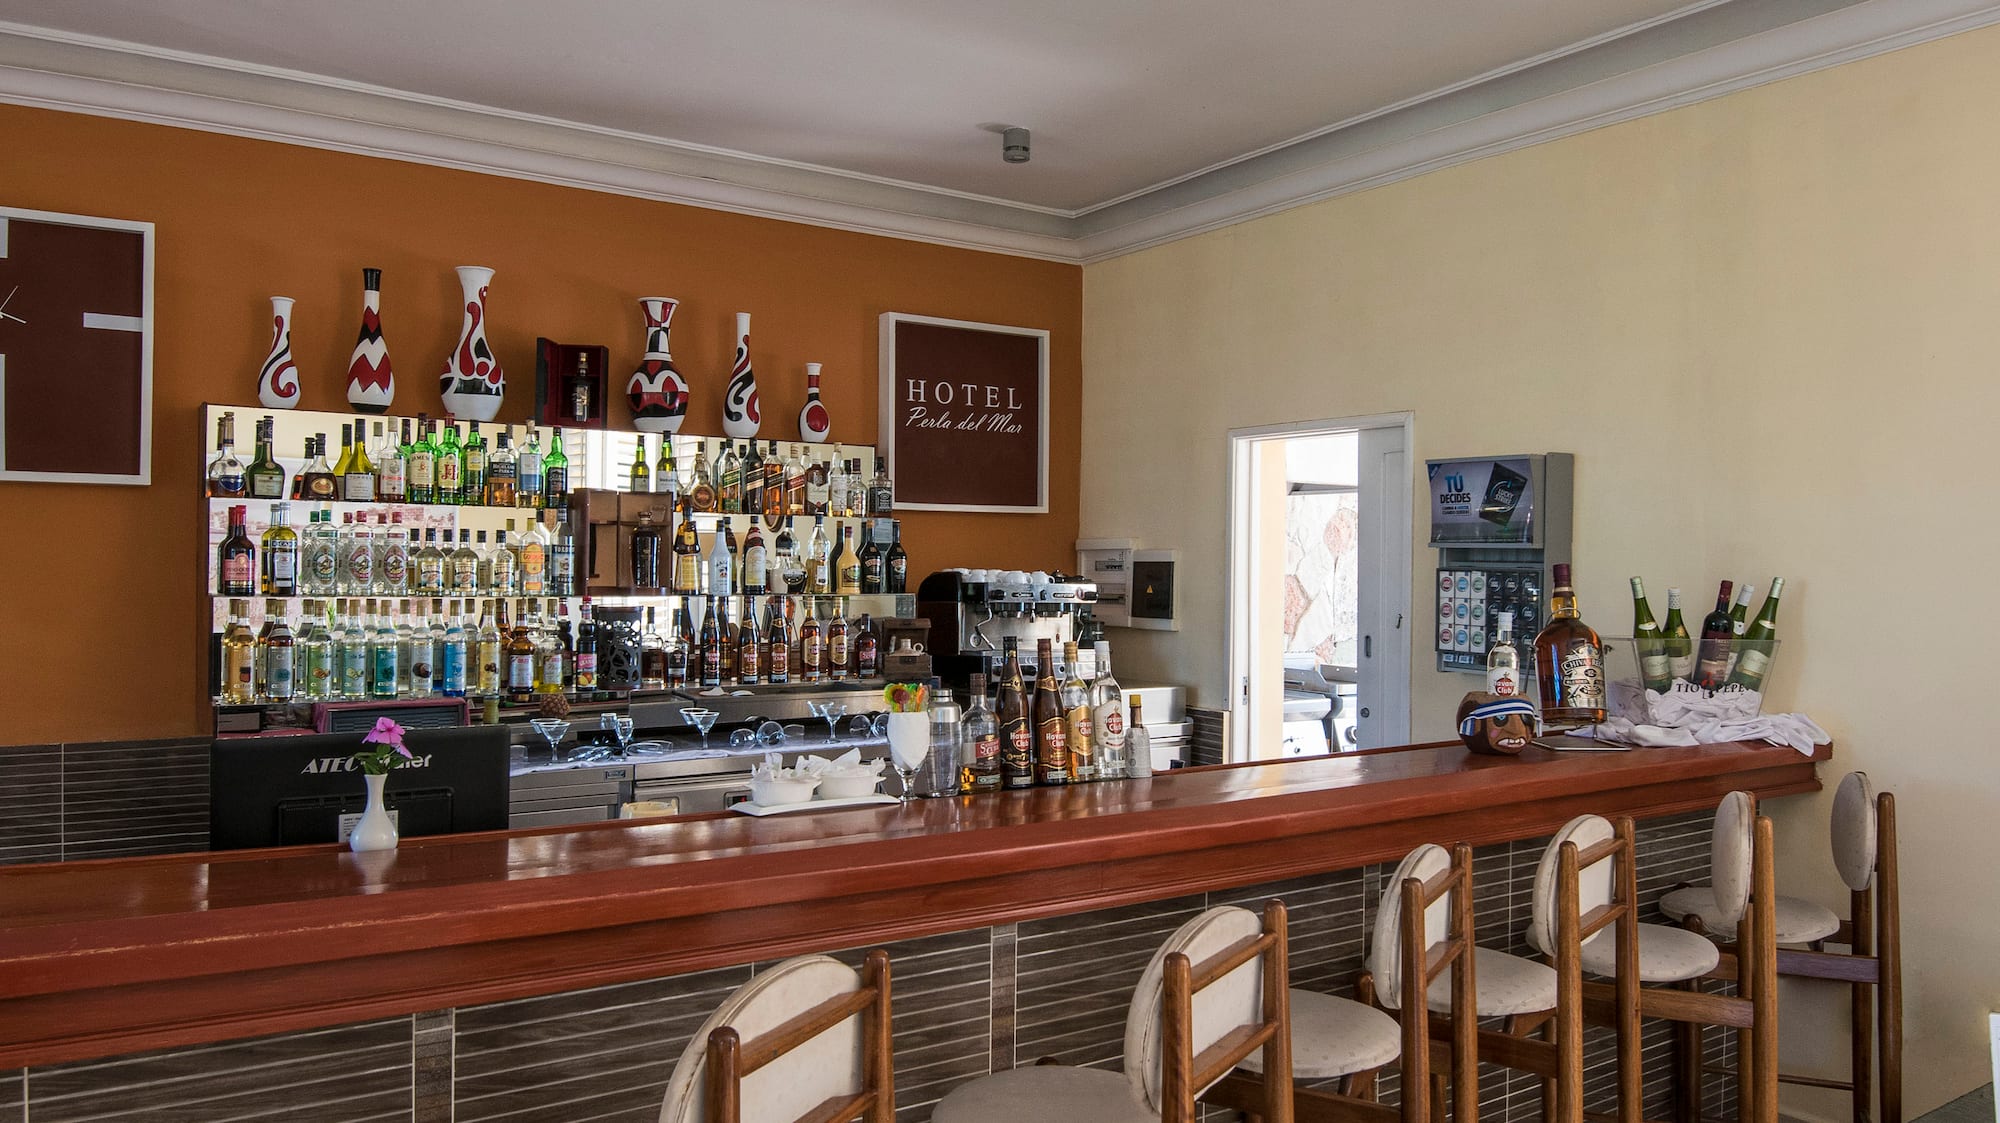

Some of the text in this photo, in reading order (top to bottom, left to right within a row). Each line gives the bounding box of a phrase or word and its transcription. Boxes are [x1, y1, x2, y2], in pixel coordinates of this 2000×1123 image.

[906, 378, 1022, 409] HOTEL
[905, 406, 1023, 434] Perla del Mar
[1445, 472, 1464, 493] TÚ
[1440, 493, 1471, 504] DECIDES
[1497, 686, 1513, 694] Club
[1676, 683, 1745, 694] TIO PEPE
[301, 757, 358, 774] ATEC
